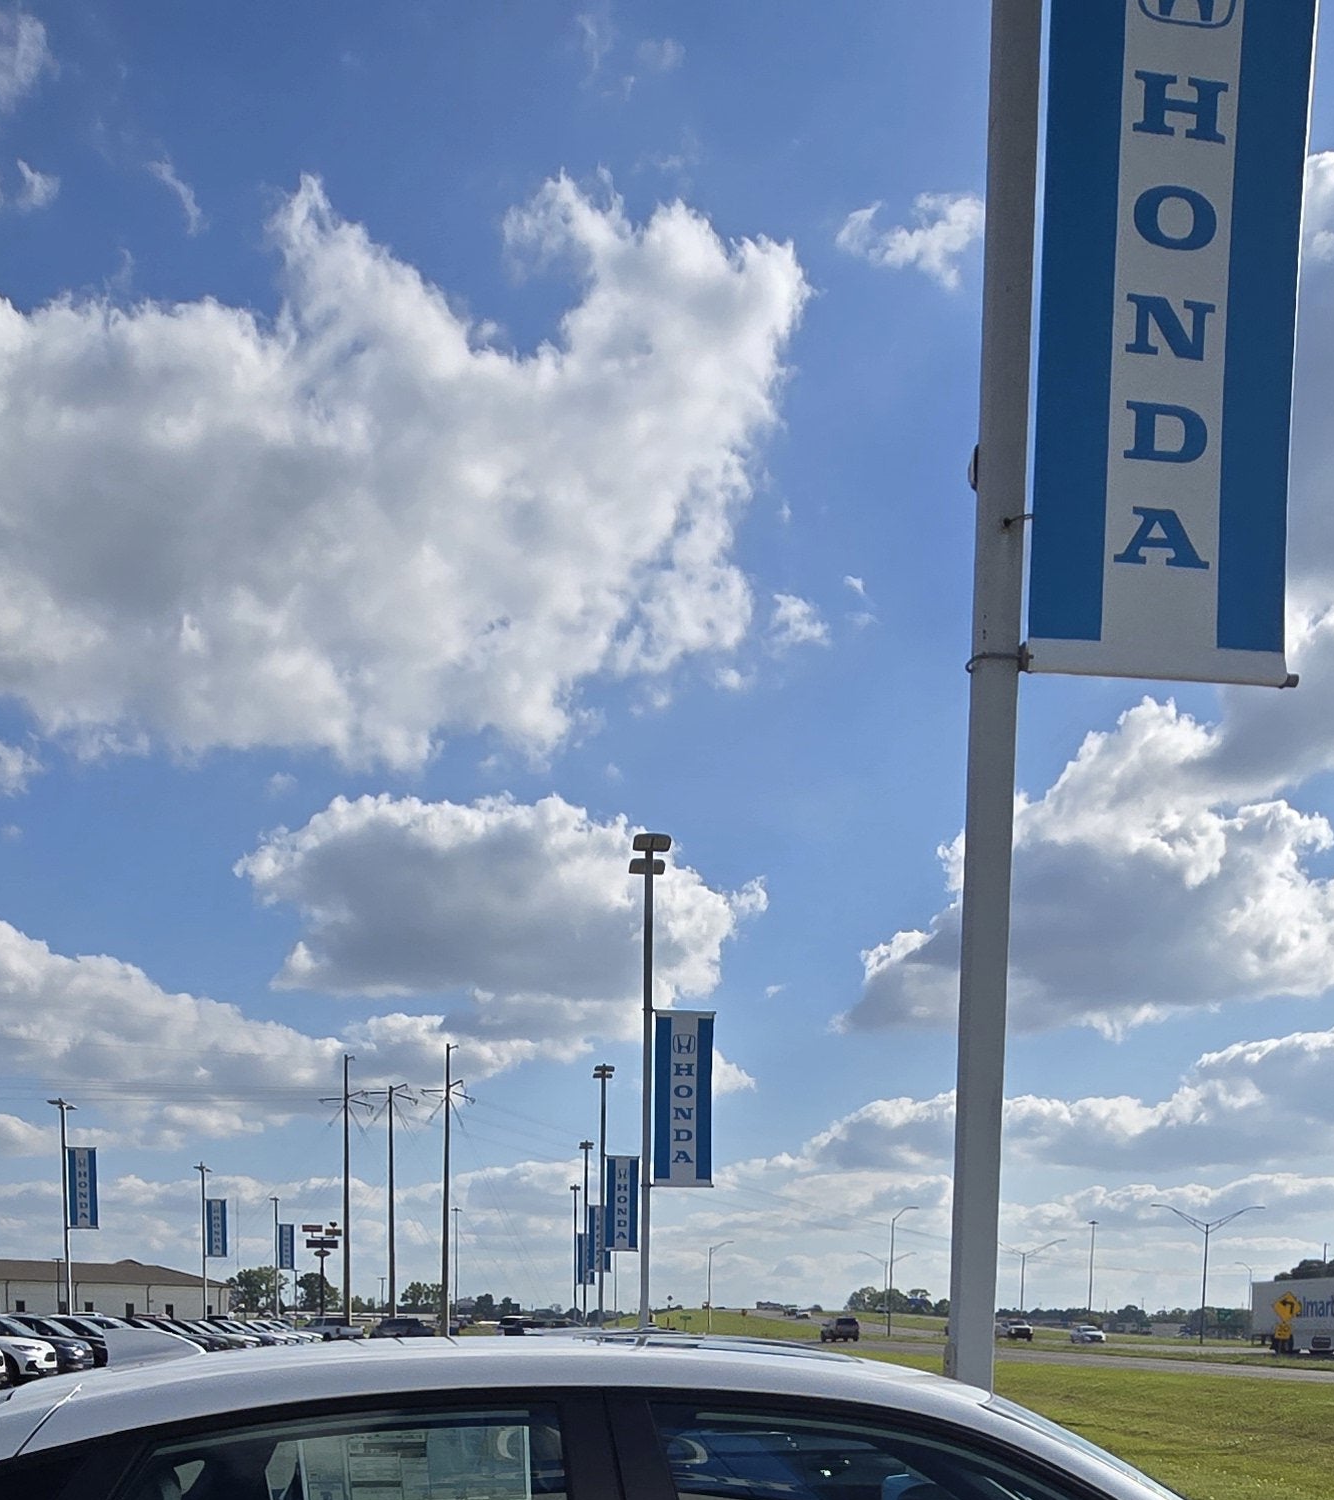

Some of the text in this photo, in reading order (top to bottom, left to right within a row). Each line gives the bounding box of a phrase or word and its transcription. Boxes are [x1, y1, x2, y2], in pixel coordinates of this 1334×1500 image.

[1113, 69, 1229, 570] HONDA
[672, 1062, 695, 1164] HONDA
[78, 1171, 88, 1219] HONDA
[616, 1184, 628, 1239] HONDA
